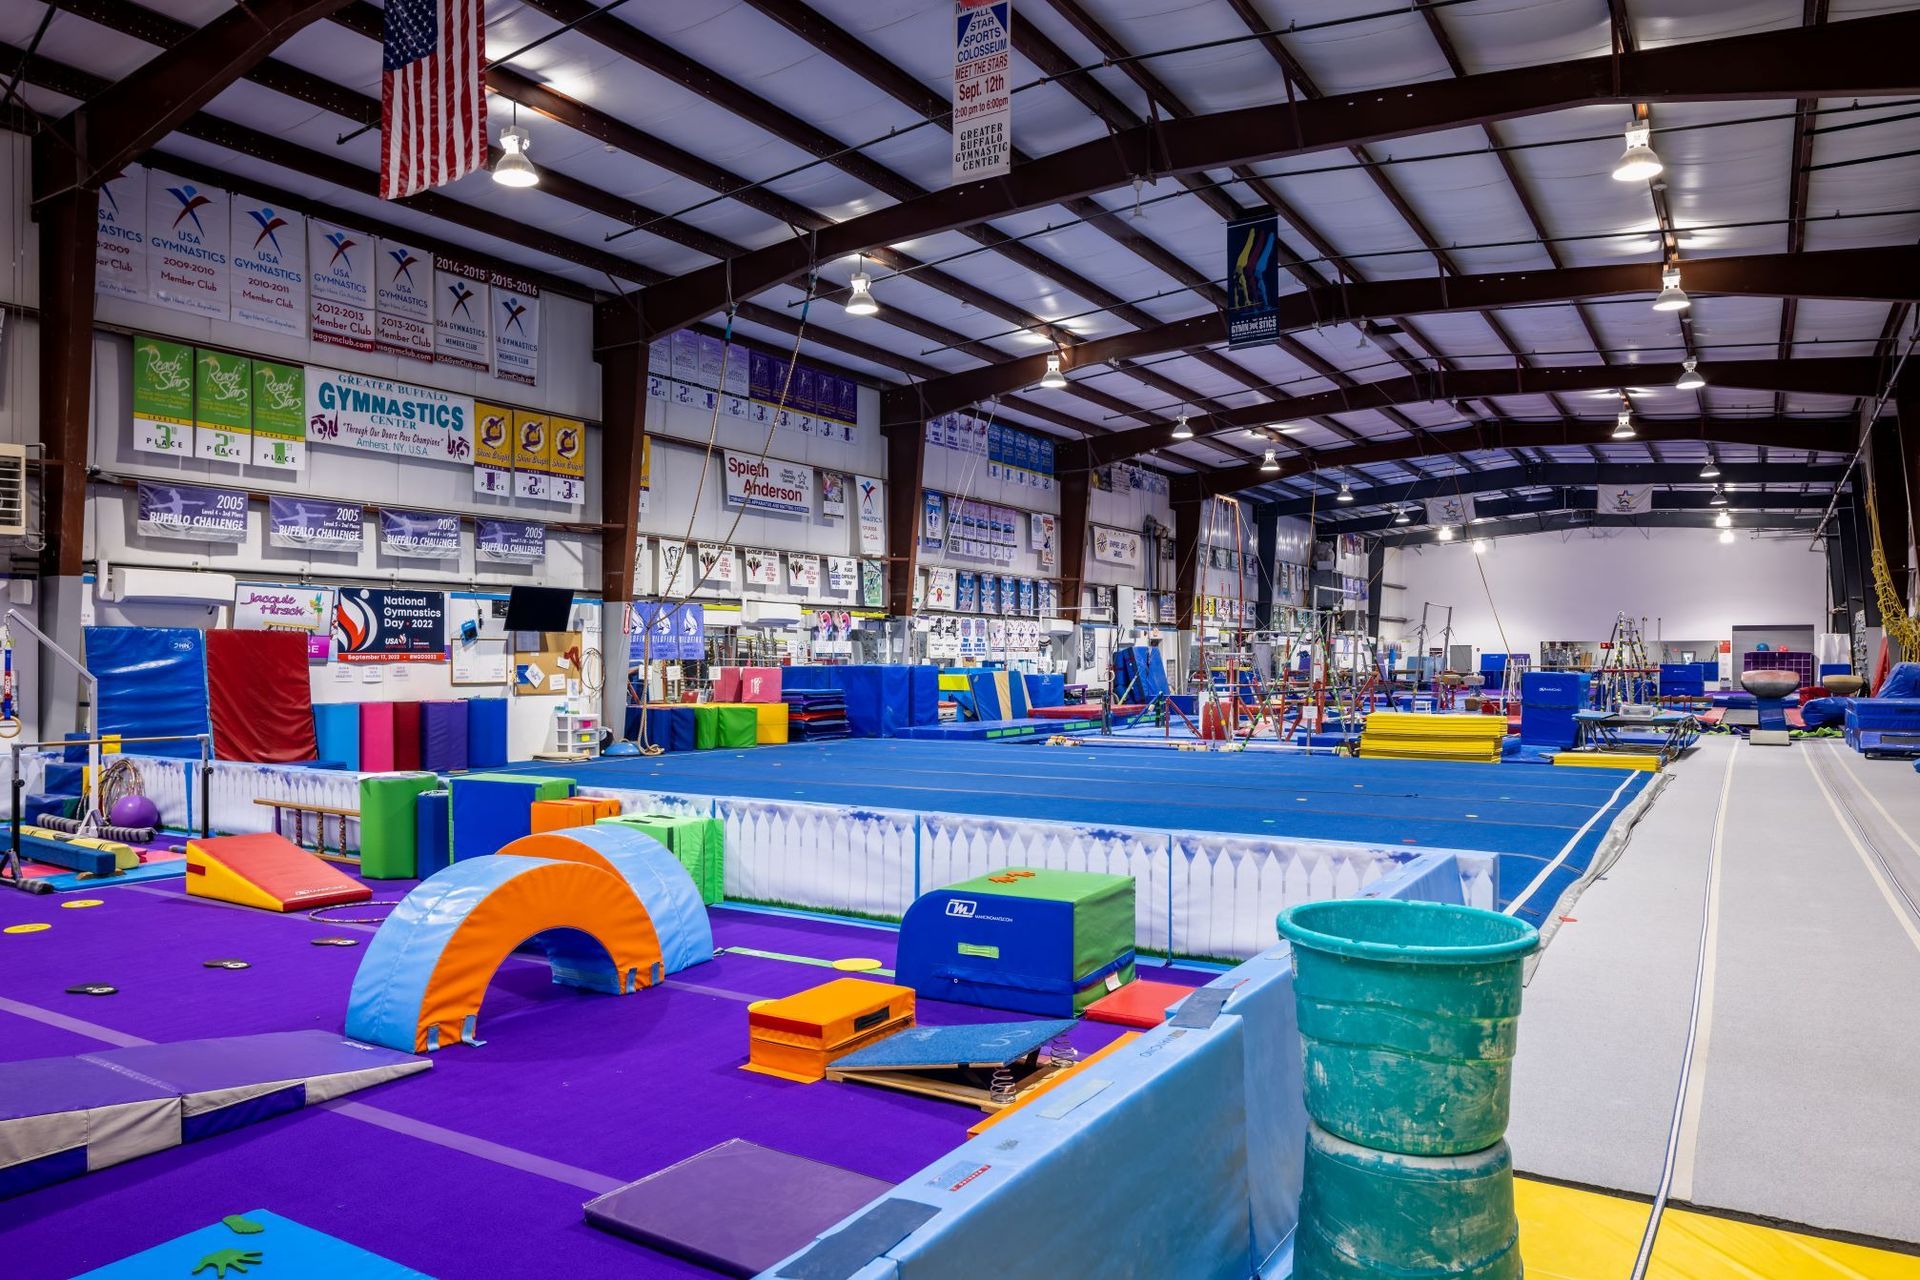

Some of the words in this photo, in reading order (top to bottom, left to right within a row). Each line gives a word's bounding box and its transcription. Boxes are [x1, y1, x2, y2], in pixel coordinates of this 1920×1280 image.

[974, 8, 990, 18] ALL
[970, 17, 994, 32] STAR
[964, 28, 1000, 48] SPORTS
[958, 38, 1007, 63] COLOSSEUM
[956, 64, 972, 80] MEET
[974, 61, 986, 74] THE
[988, 54, 1008, 71] STARS
[960, 81, 981, 102] Sept.
[986, 74, 1004, 95] 12th
[968, 104, 978, 117] pm
[979, 102, 986, 112] to
[960, 122, 1003, 141] GREATER
[960, 132, 1003, 151] BUFFALO
[956, 142, 1008, 163] GYMNASTIC
[963, 154, 1000, 172] CENTER
[178, 231, 201, 245] USA
[152, 236, 226, 264] GYMNASTICS
[258, 252, 279, 265] USA
[111, 260, 133, 273] Club
[164, 257, 215, 276] 2009-2010
[234, 257, 302, 284] GYMNASTICS
[333, 268, 350, 279] USA
[436, 256, 486, 281] 2014-2015
[161, 270, 196, 288] Member
[197, 278, 218, 292] Club
[248, 278, 290, 294] 2010-2011
[314, 273, 367, 295] GYMNASTICS
[396, 283, 412, 294] USA
[491, 272, 538, 297] 2015-2016
[242, 290, 274, 305] Member
[275, 298, 294, 310] Club
[379, 288, 428, 309] GYMNASTICS
[316, 302, 364, 322] 2012-2013
[313, 314, 348, 332] Member
[350, 322, 372, 336] Club
[382, 316, 425, 335] 2013-2014
[450, 322, 486, 338] GYMNASTICS
[378, 326, 410, 343] Member
[412, 335, 432, 348] Club
[446, 338, 465, 349] MEMBER
[466, 342, 478, 351] CLUB
[502, 337, 538, 353] GYMNASTICS
[338, 374, 394, 392] GREATER
[398, 384, 448, 402] BUFFALO
[318, 382, 464, 432] GYMNASTICS
[370, 415, 417, 430] CENTER
[146, 437, 183, 448] PLACE
[156, 424, 170, 450] 3
[370, 427, 380, 438] Our
[382, 429, 398, 440] Doors
[400, 432, 411, 442] Pass
[206, 446, 240, 456] PLACE
[215, 433, 228, 457] 2
[272, 442, 286, 465] 1
[264, 452, 296, 463] PLACE
[728, 457, 769, 478] Spieth
[485, 472, 496, 491] 1
[529, 476, 538, 496] 2
[564, 480, 572, 500] 3
[744, 479, 802, 502] Anderson
[217, 494, 244, 510] 2005
[150, 511, 190, 526] BUFFALO
[193, 516, 244, 532] CHALLENGE
[336, 508, 360, 522] 2005
[437, 518, 457, 531] 2005
[279, 524, 314, 538] BUFFALO
[316, 527, 360, 541] CHALLENGE
[387, 534, 418, 546] BUFFALO
[420, 536, 457, 549] CHALLENGE
[525, 526, 543, 539] 2005
[481, 541, 509, 553] BUFFALO
[510, 544, 543, 555] CHALLENGE
[384, 596, 426, 606] National
[384, 608, 442, 618] Gymnastics
[384, 619, 404, 630] Day
[412, 620, 433, 628] 2022
